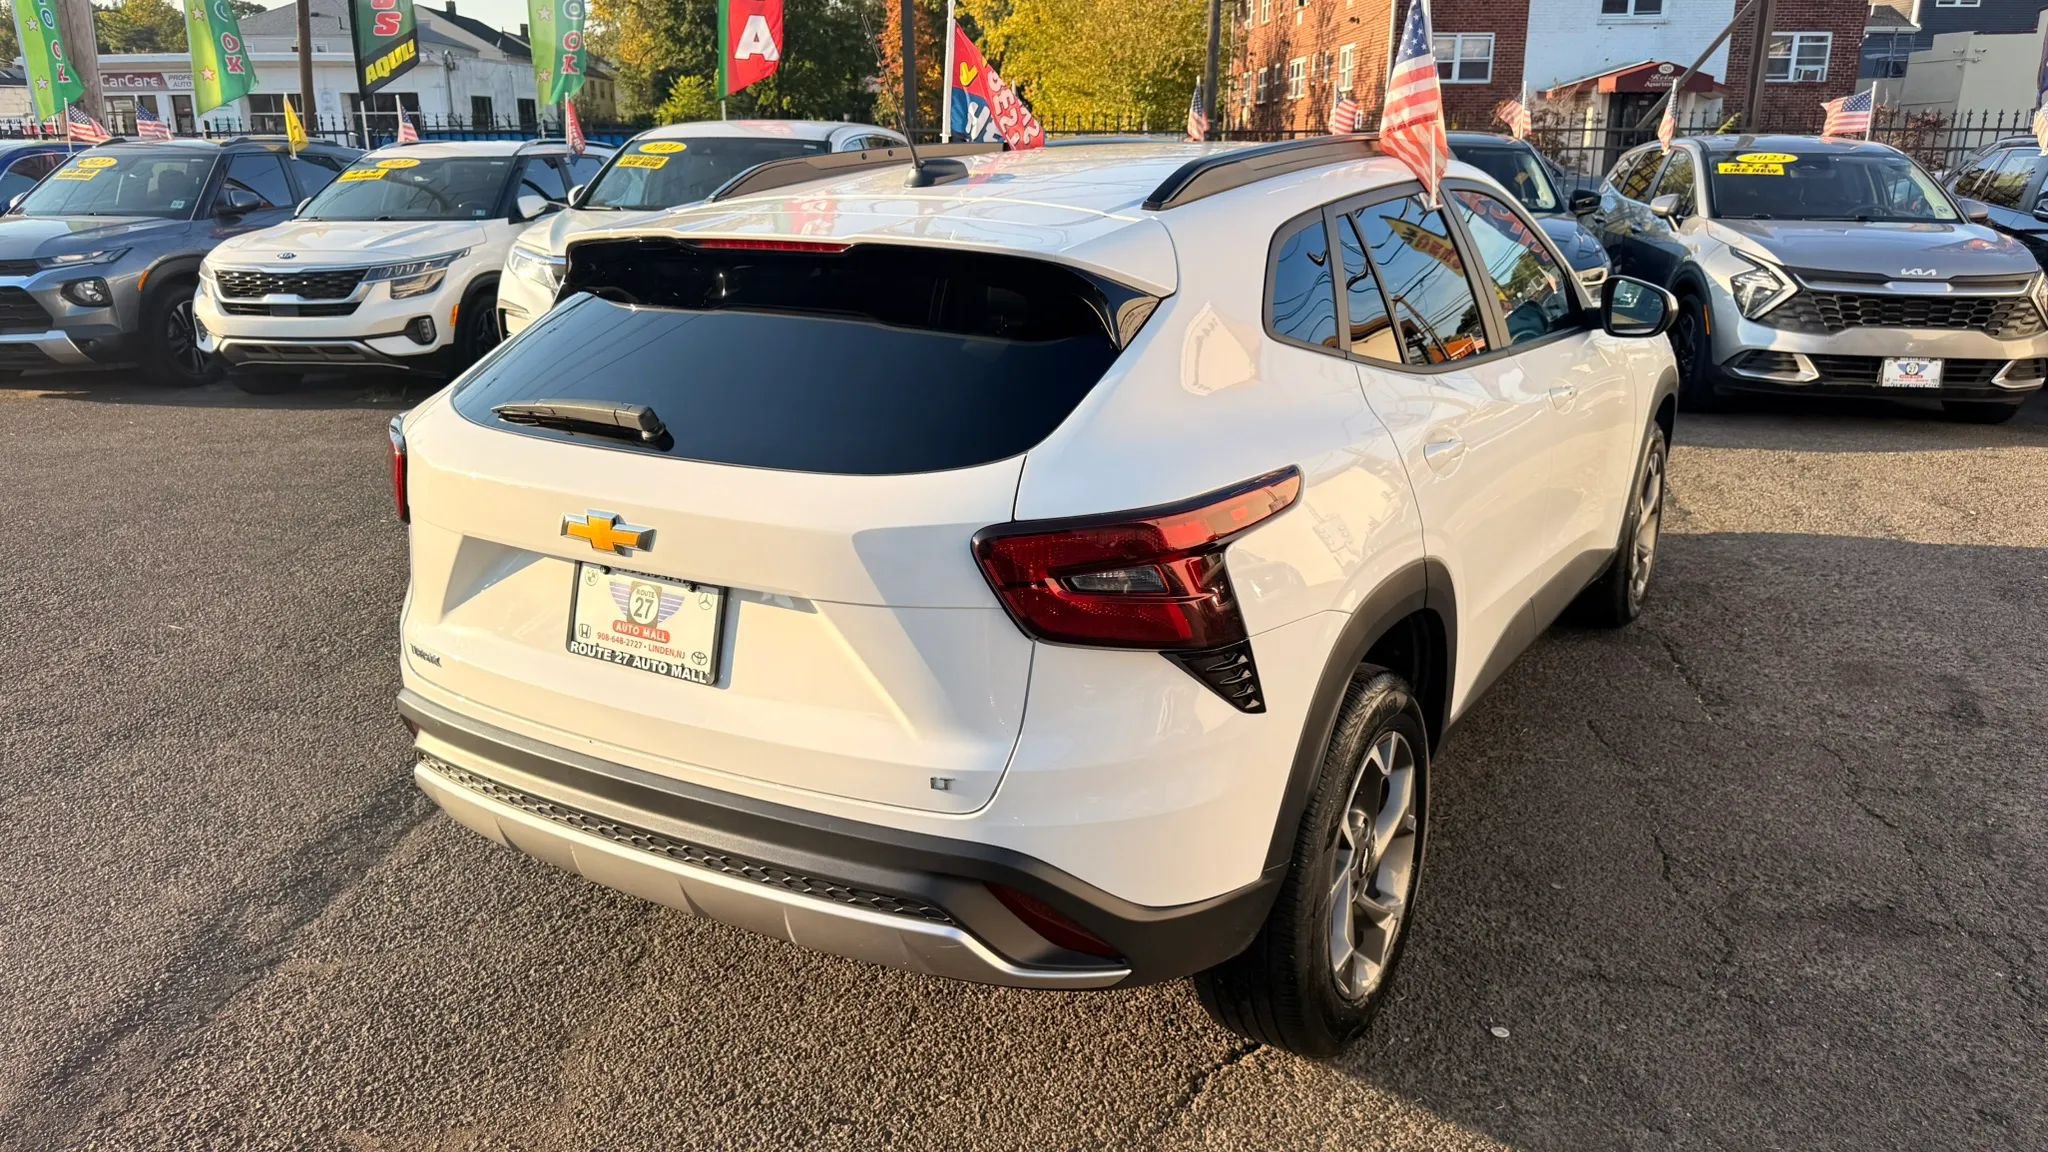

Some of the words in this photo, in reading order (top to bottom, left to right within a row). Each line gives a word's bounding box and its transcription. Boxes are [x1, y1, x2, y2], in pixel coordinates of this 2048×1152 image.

[221, 32, 245, 74] OK
[561, 30, 582, 74] OK
[101, 74, 159, 87] CarCare
[636, 588, 656, 599] ROUTE
[633, 597, 655, 620] 27
[615, 621, 641, 636] AUTO
[642, 627, 668, 642] MALL
[570, 641, 612, 661] ROUTE
[614, 652, 630, 665] 27
[632, 656, 668, 674] AUTO
[671, 664, 707, 684] MALL
